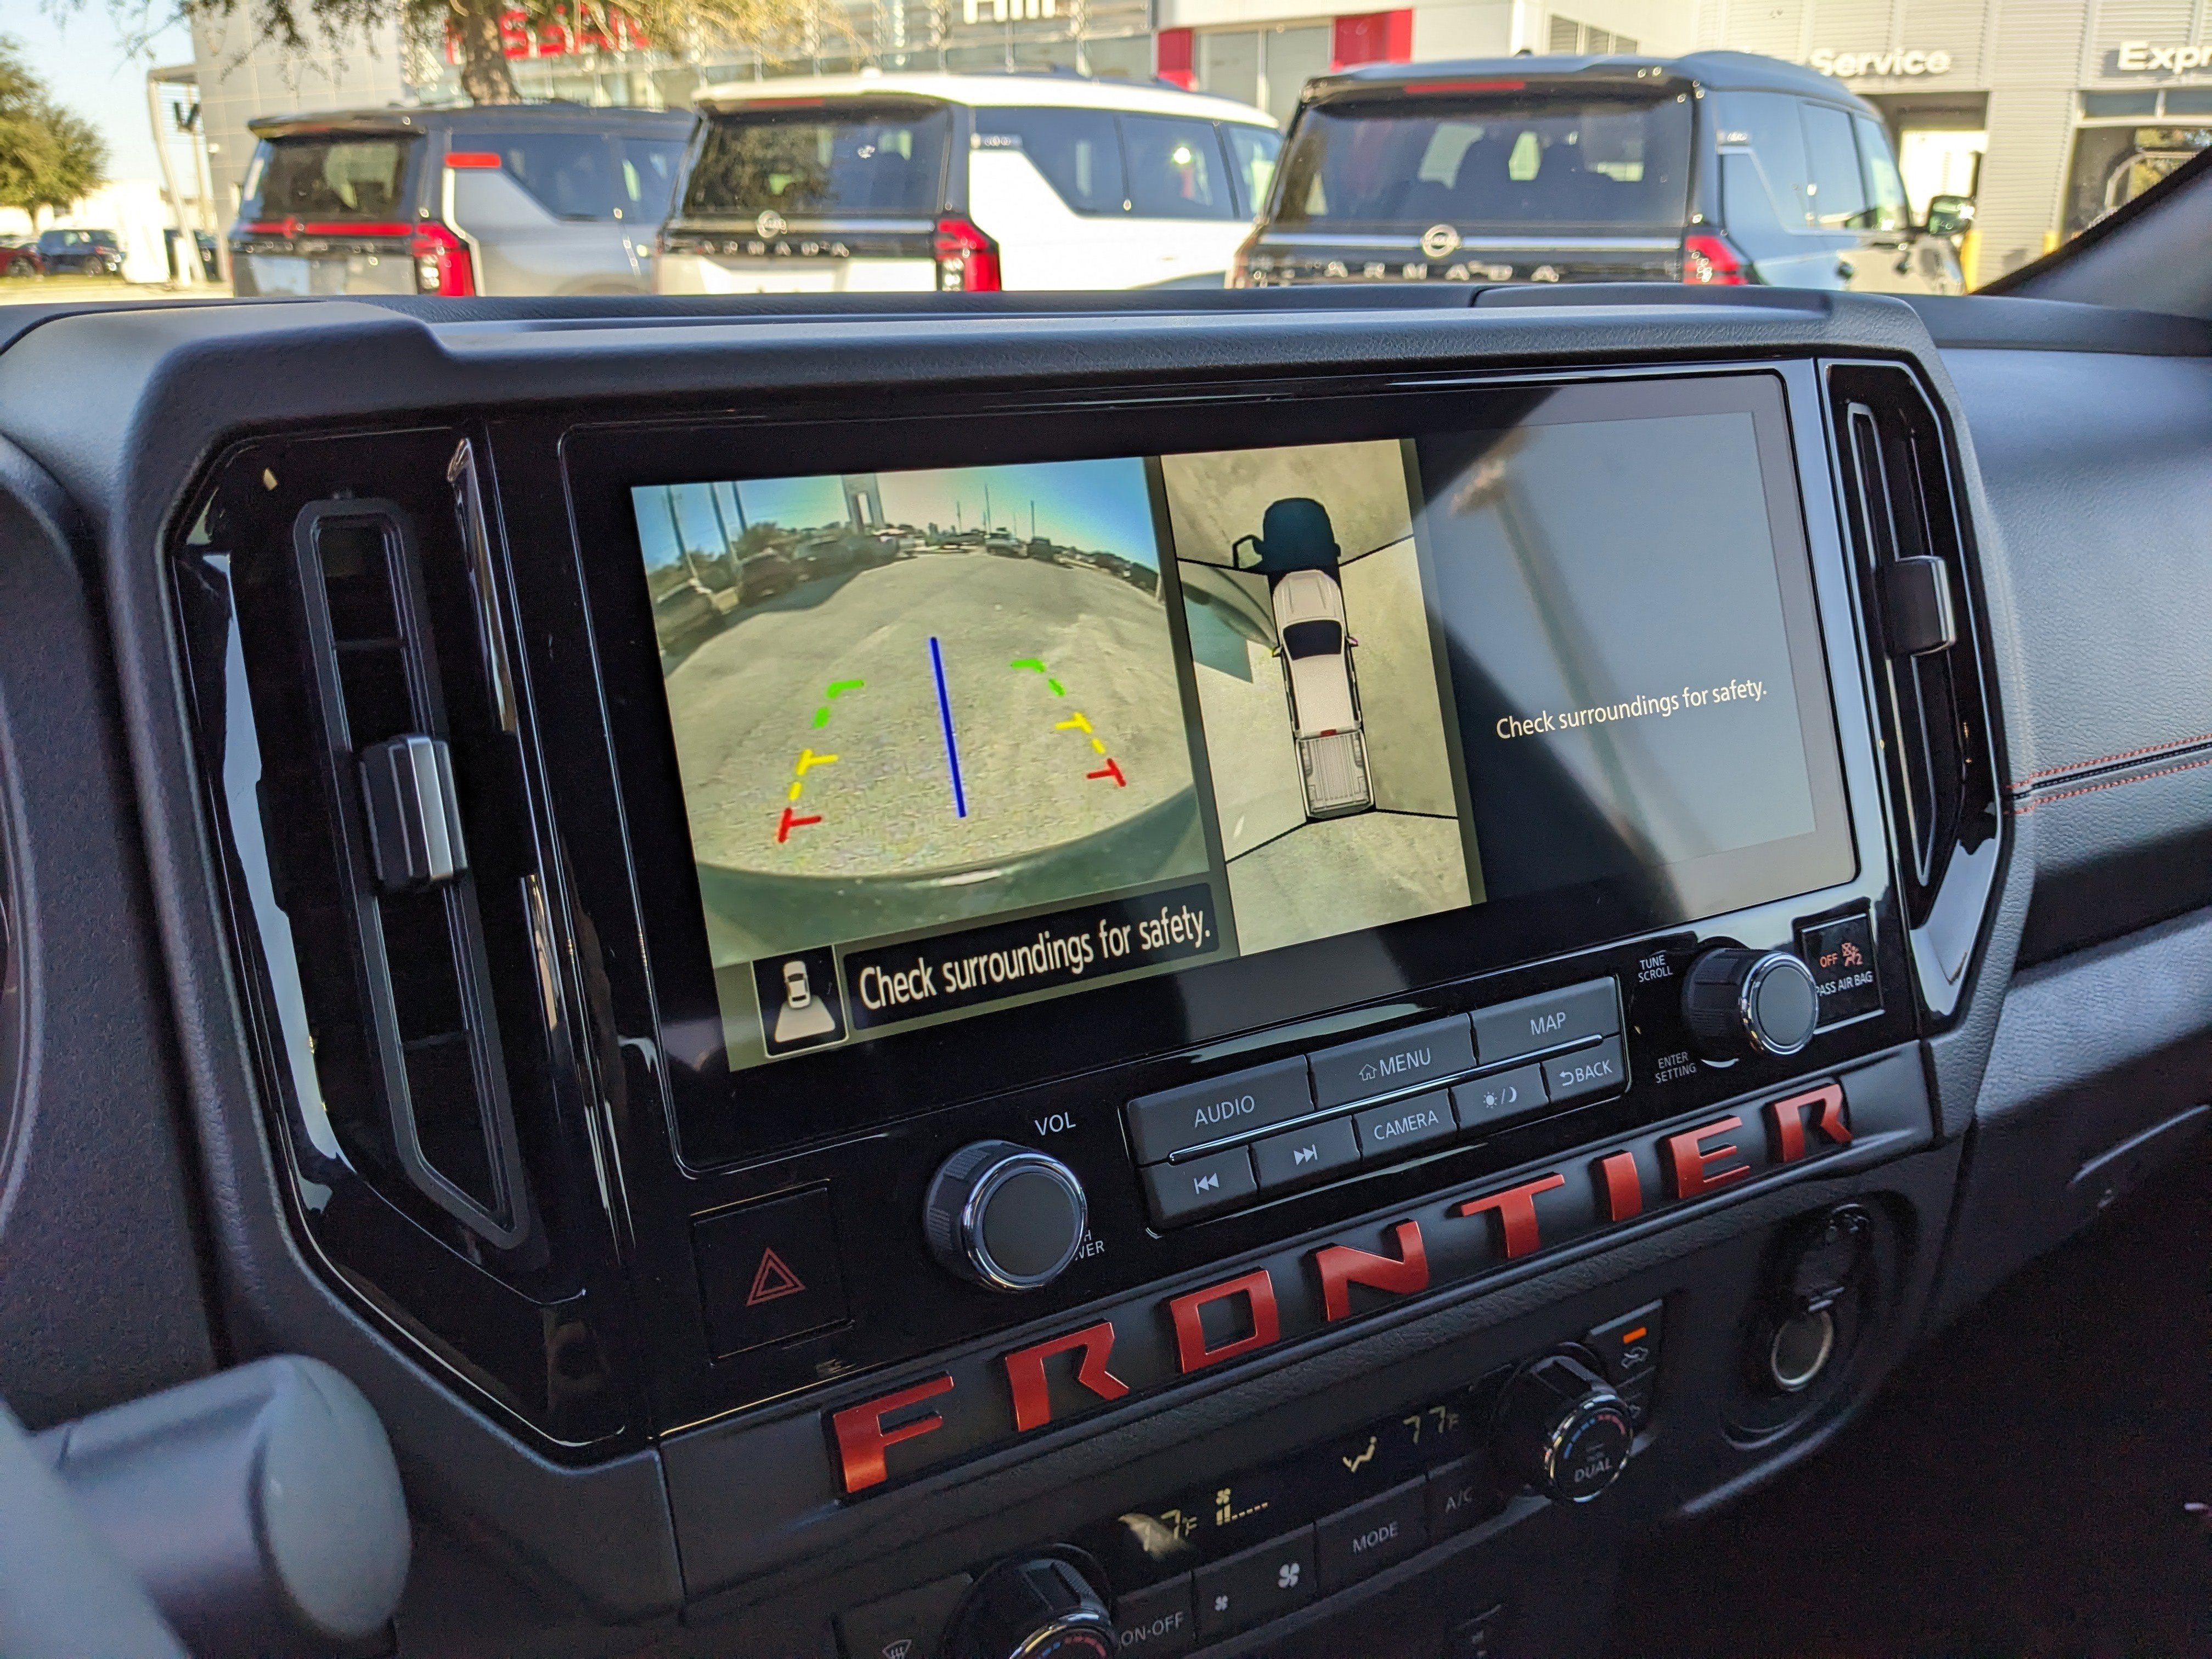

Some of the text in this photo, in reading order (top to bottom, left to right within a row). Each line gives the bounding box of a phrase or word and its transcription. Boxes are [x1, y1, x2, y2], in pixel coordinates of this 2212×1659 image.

[1810, 49, 1951, 77] Service
[1496, 679, 1768, 740] Check surroundings for safety.
[858, 904, 1211, 1011] Check surroundings for safety.
[1639, 955, 1666, 970] TUNE
[1819, 952, 1838, 969] OFF
[1638, 966, 1674, 983] SCROLL
[1815, 970, 1874, 996] PASS AIR BAG
[1530, 1011, 1567, 1036] MAP
[1379, 1047, 1432, 1076] MENU
[1575, 1059, 1613, 1083] BACK
[1657, 1051, 1689, 1069] ENTER
[1655, 1063, 1697, 1084] SETTING
[1035, 1111, 1076, 1136] VOL
[1194, 1094, 1256, 1128] AUDIO
[1374, 1110, 1438, 1141] CAMERA
[833, 1082, 1854, 1496] FRONTIER
[1573, 1458, 1612, 1482] DUAL
[1445, 1487, 1472, 1513] A/C
[1352, 1522, 1399, 1555] MODE
